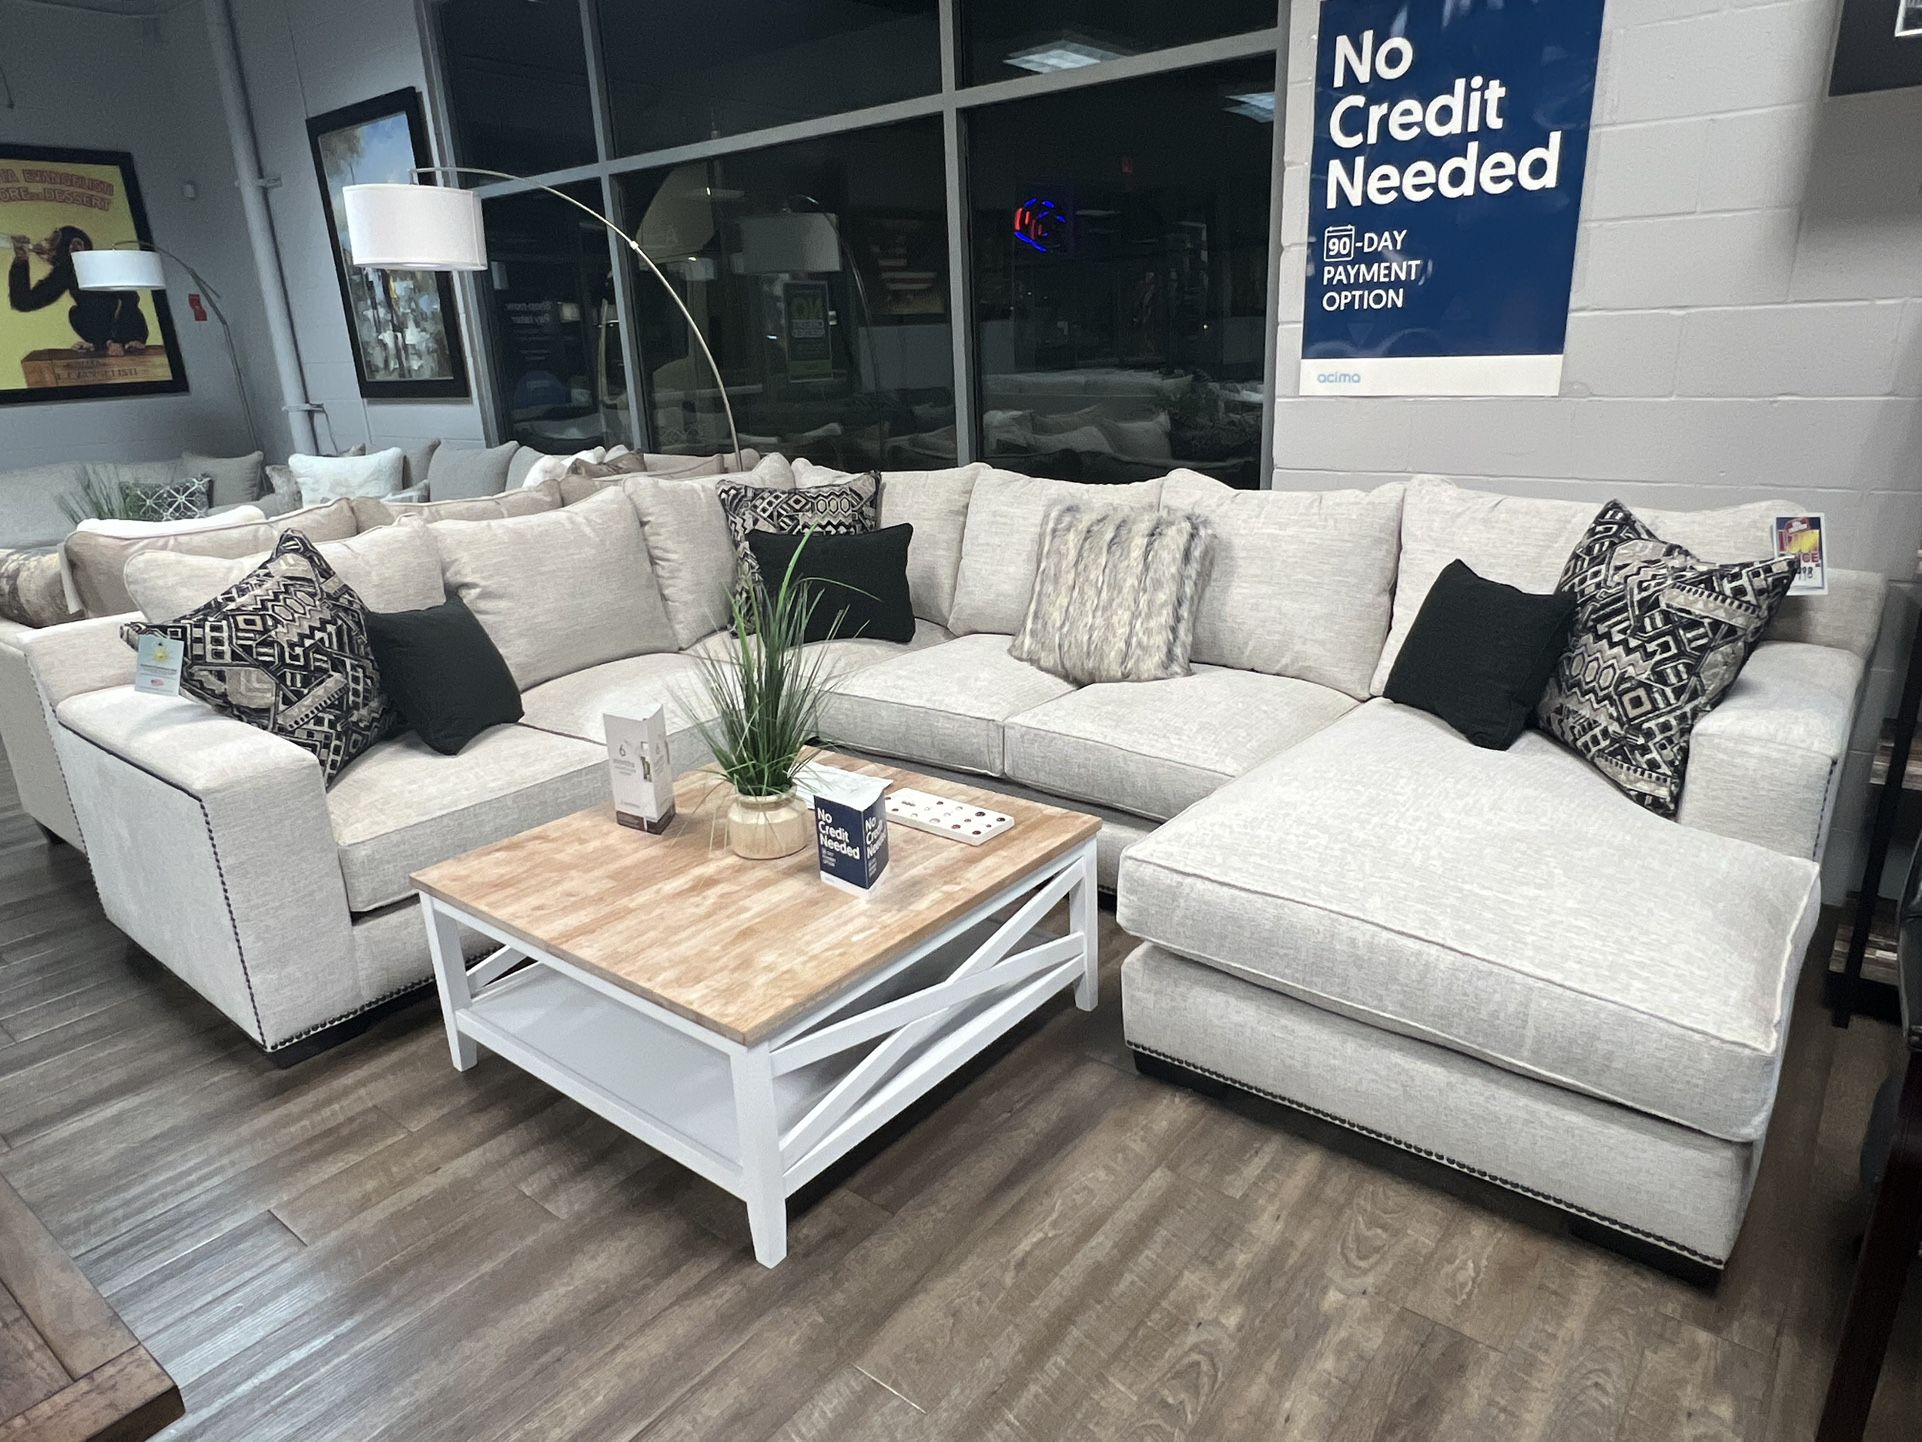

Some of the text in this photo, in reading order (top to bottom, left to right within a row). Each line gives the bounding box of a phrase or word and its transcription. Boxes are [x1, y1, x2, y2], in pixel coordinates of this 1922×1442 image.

[1333, 29, 1414, 88] No
[1328, 76, 1506, 149] Credit
[1325, 130, 1562, 209] Needed
[43, 187, 112, 212] DESSERT
[1323, 260, 1421, 285] PAYMENT
[1322, 288, 1404, 311] OPTION
[1317, 371, 1361, 384] acima
[817, 807, 833, 824] No
[865, 816, 877, 833] No
[818, 820, 850, 843] Credit
[819, 833, 860, 860] Needed
